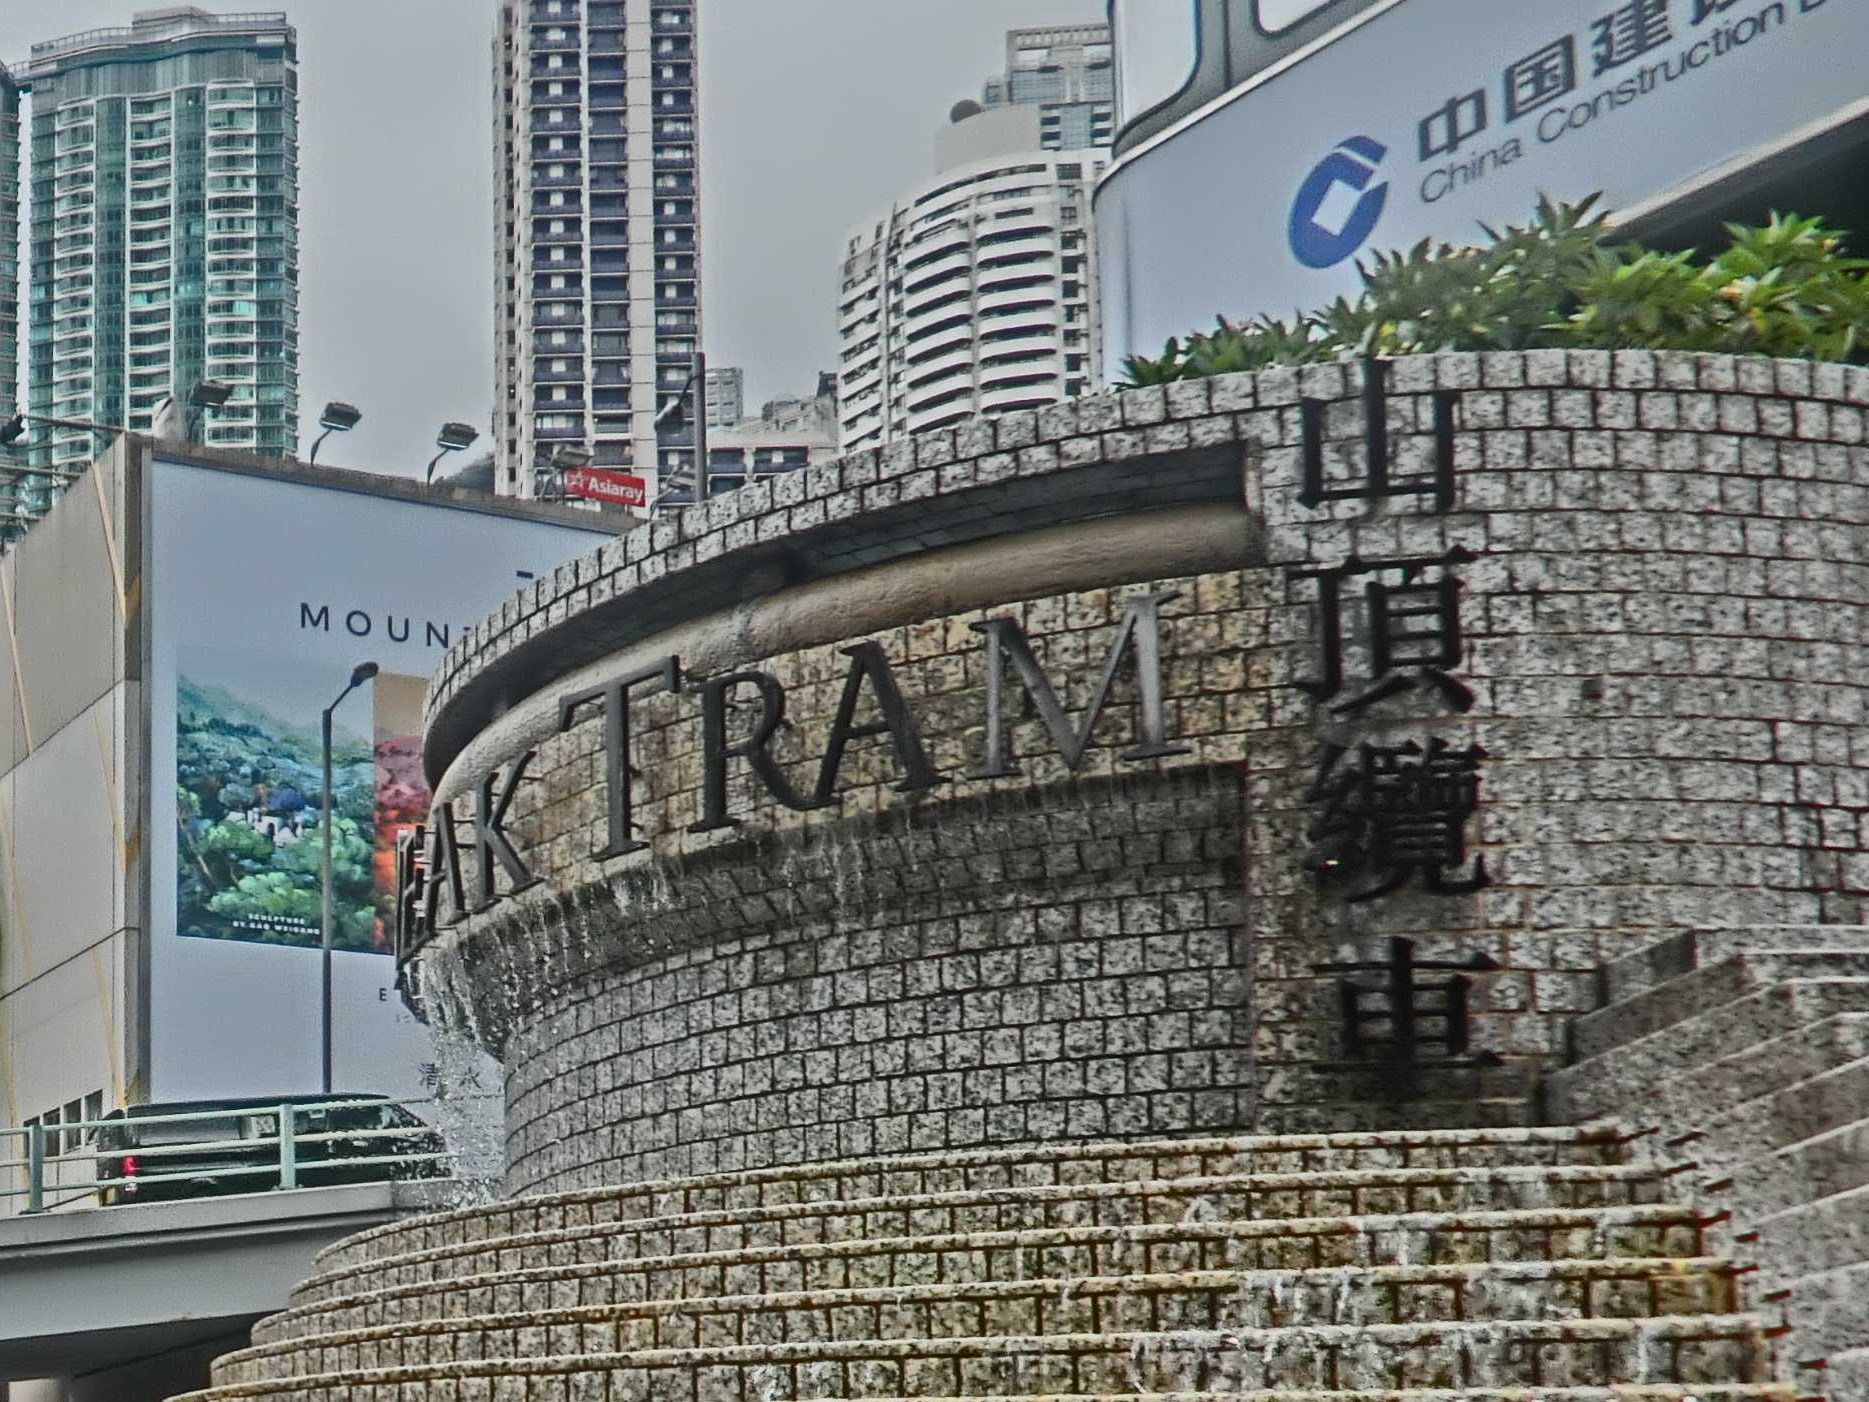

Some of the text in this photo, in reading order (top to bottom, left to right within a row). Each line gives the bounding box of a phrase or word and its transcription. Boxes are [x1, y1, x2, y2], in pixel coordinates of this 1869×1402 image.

[1418, 0, 1736, 162] 中国建
[1420, 2, 1785, 203] China Construction
[588, 476, 644, 504] Asiaray
[300, 602, 471, 649] MOUN
[558, 590, 1192, 862] TRAM
[1287, 357, 1506, 1093] 山頂纜車
[248, 913, 305, 925] SCULPTURE
